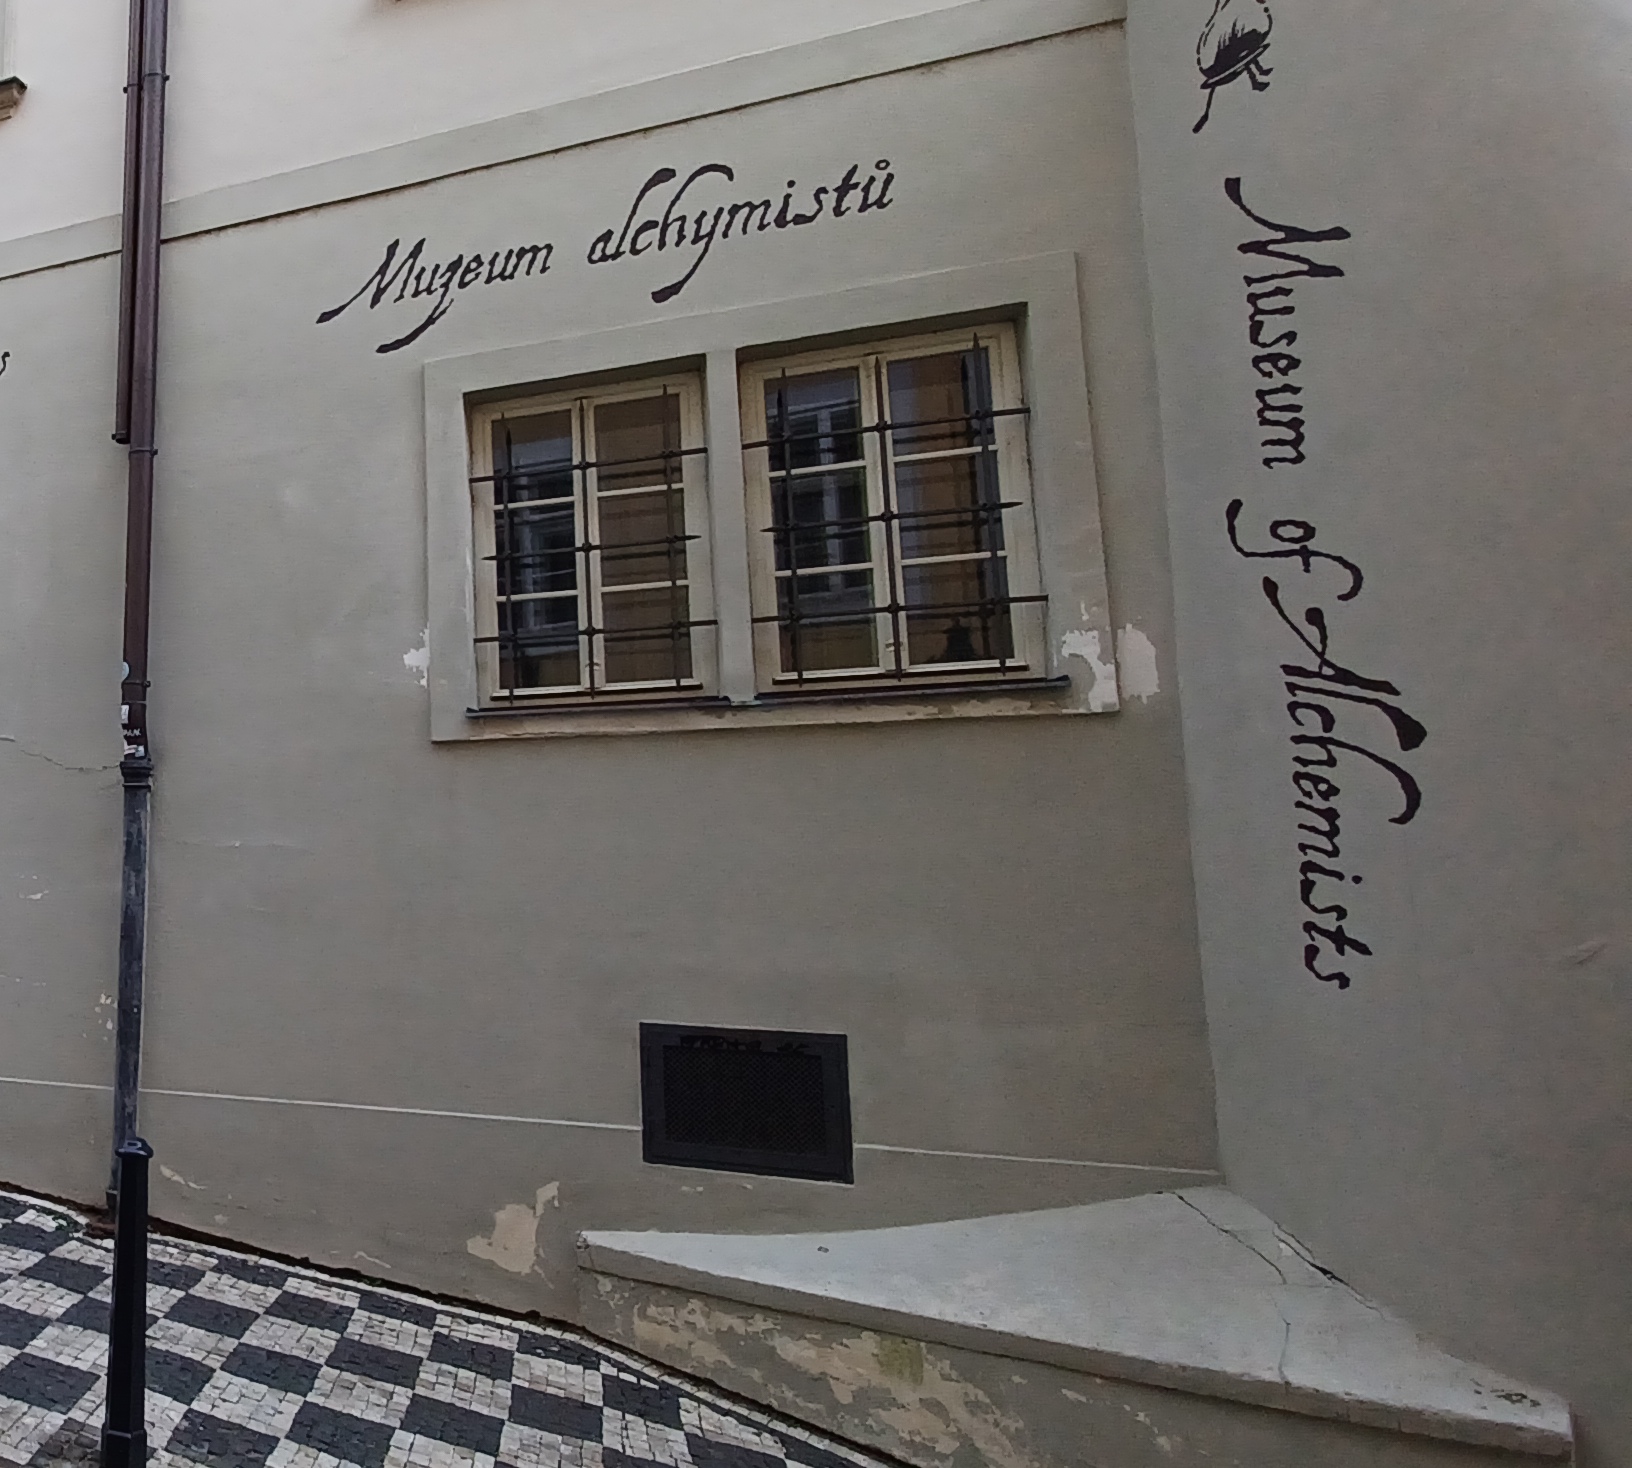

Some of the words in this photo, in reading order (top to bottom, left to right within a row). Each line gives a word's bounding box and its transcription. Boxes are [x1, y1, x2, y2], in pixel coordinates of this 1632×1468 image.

[316, 237, 552, 354] Muzeum
[586, 159, 894, 304] alchymistů
[1224, 177, 1352, 470] Museum
[1225, 498, 1364, 602] of
[1262, 576, 1428, 990] Alchemists
